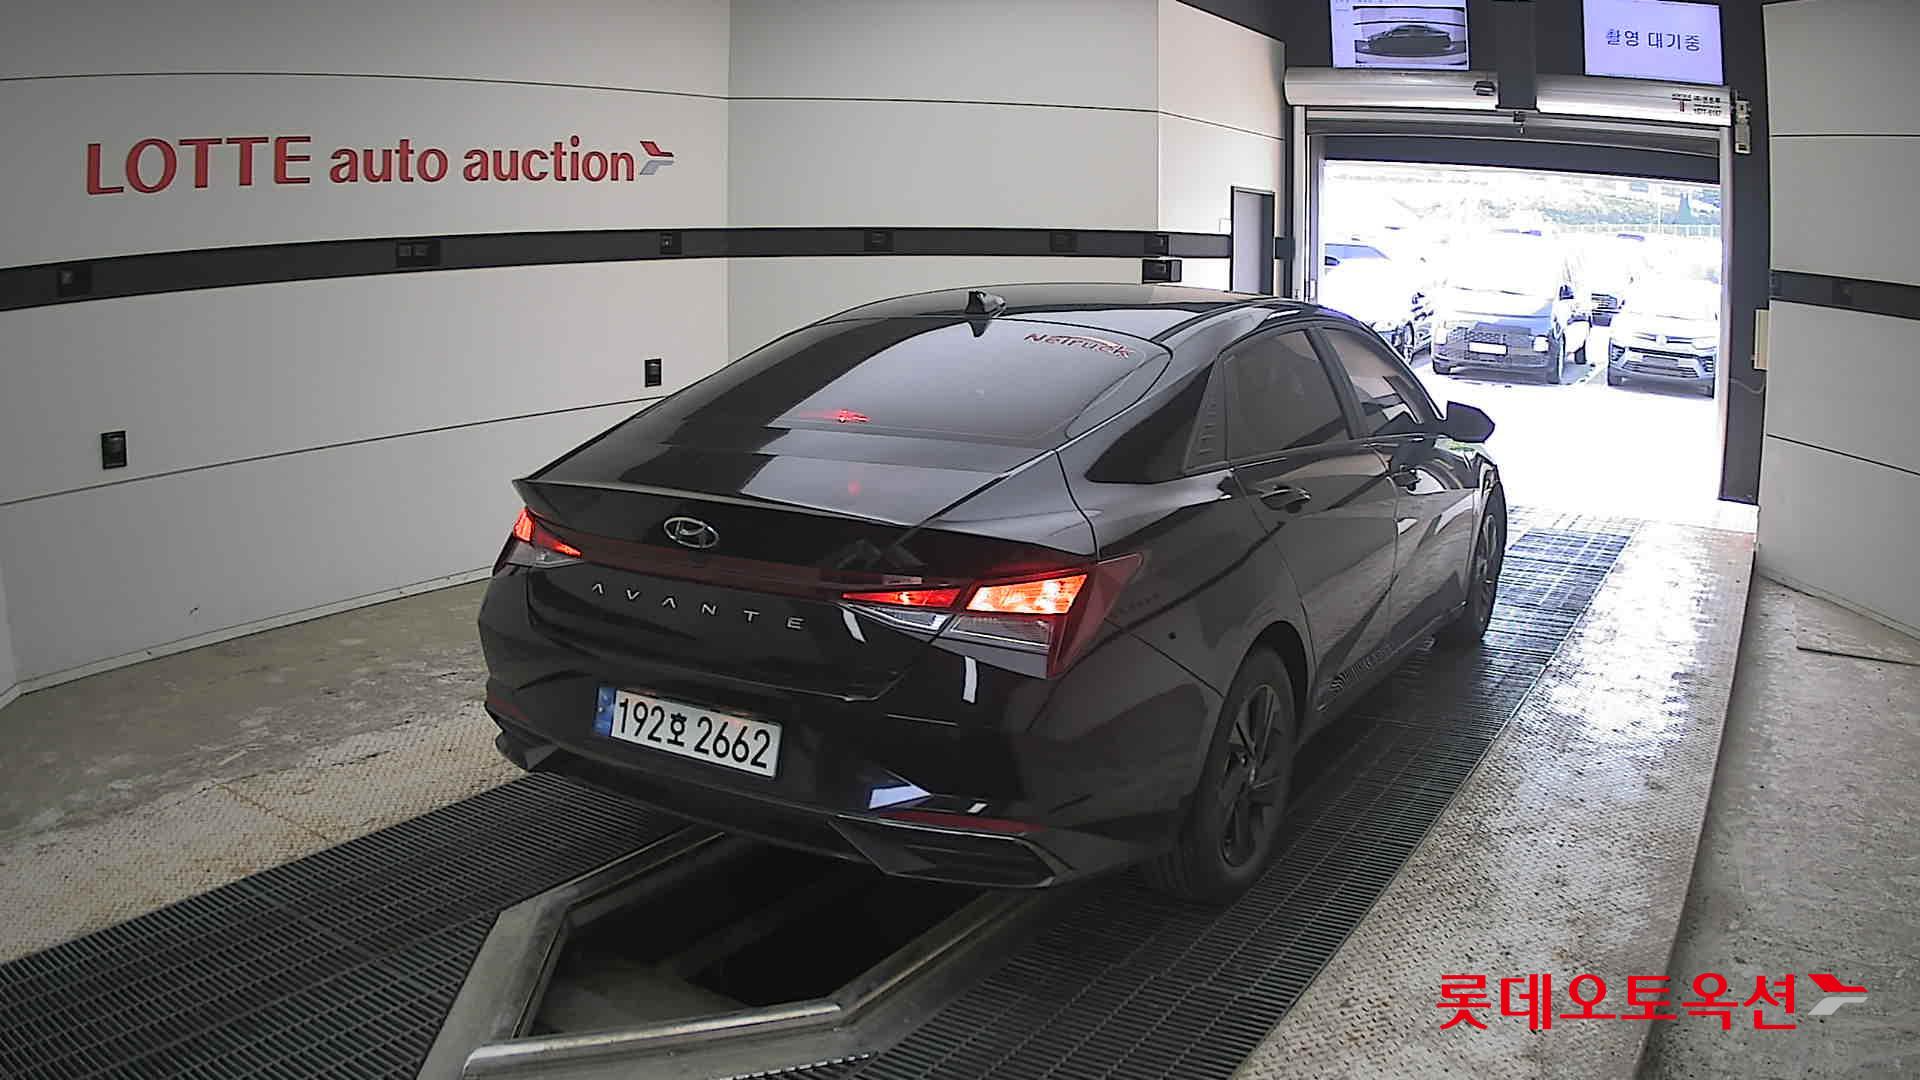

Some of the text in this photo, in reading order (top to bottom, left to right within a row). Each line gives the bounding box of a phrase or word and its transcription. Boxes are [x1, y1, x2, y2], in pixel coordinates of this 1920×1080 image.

[1647, 32, 1700, 52] 대기중
[86, 135, 635, 195] LOTTE auto auction
[592, 583, 804, 630] AVANTE
[619, 698, 772, 769] 192호 2662
